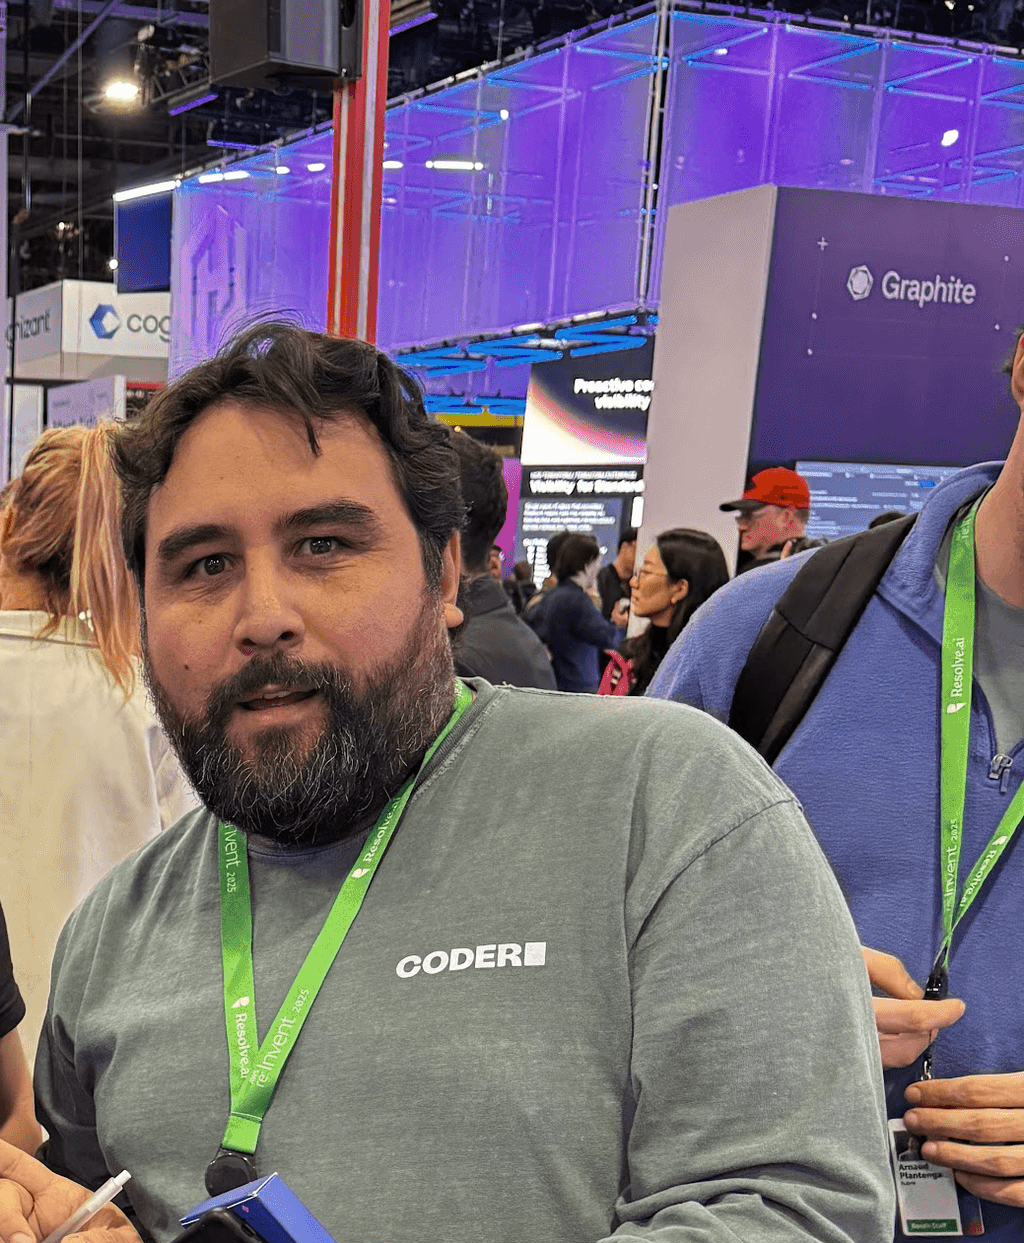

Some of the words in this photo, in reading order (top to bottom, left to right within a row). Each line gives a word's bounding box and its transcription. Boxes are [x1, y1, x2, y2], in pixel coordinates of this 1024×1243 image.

[881, 270, 976, 308] Graphite
[950, 637, 965, 698] Resolve.ai
[950, 818, 959, 841] 2025
[226, 871, 237, 893] 2025
[395, 942, 523, 979] CODER
[255, 1015, 297, 1088] re:Invent
[292, 988, 310, 1014] 2025
[898, 1163, 929, 1172] Arnaud
[899, 1171, 943, 1180] Plantenga
